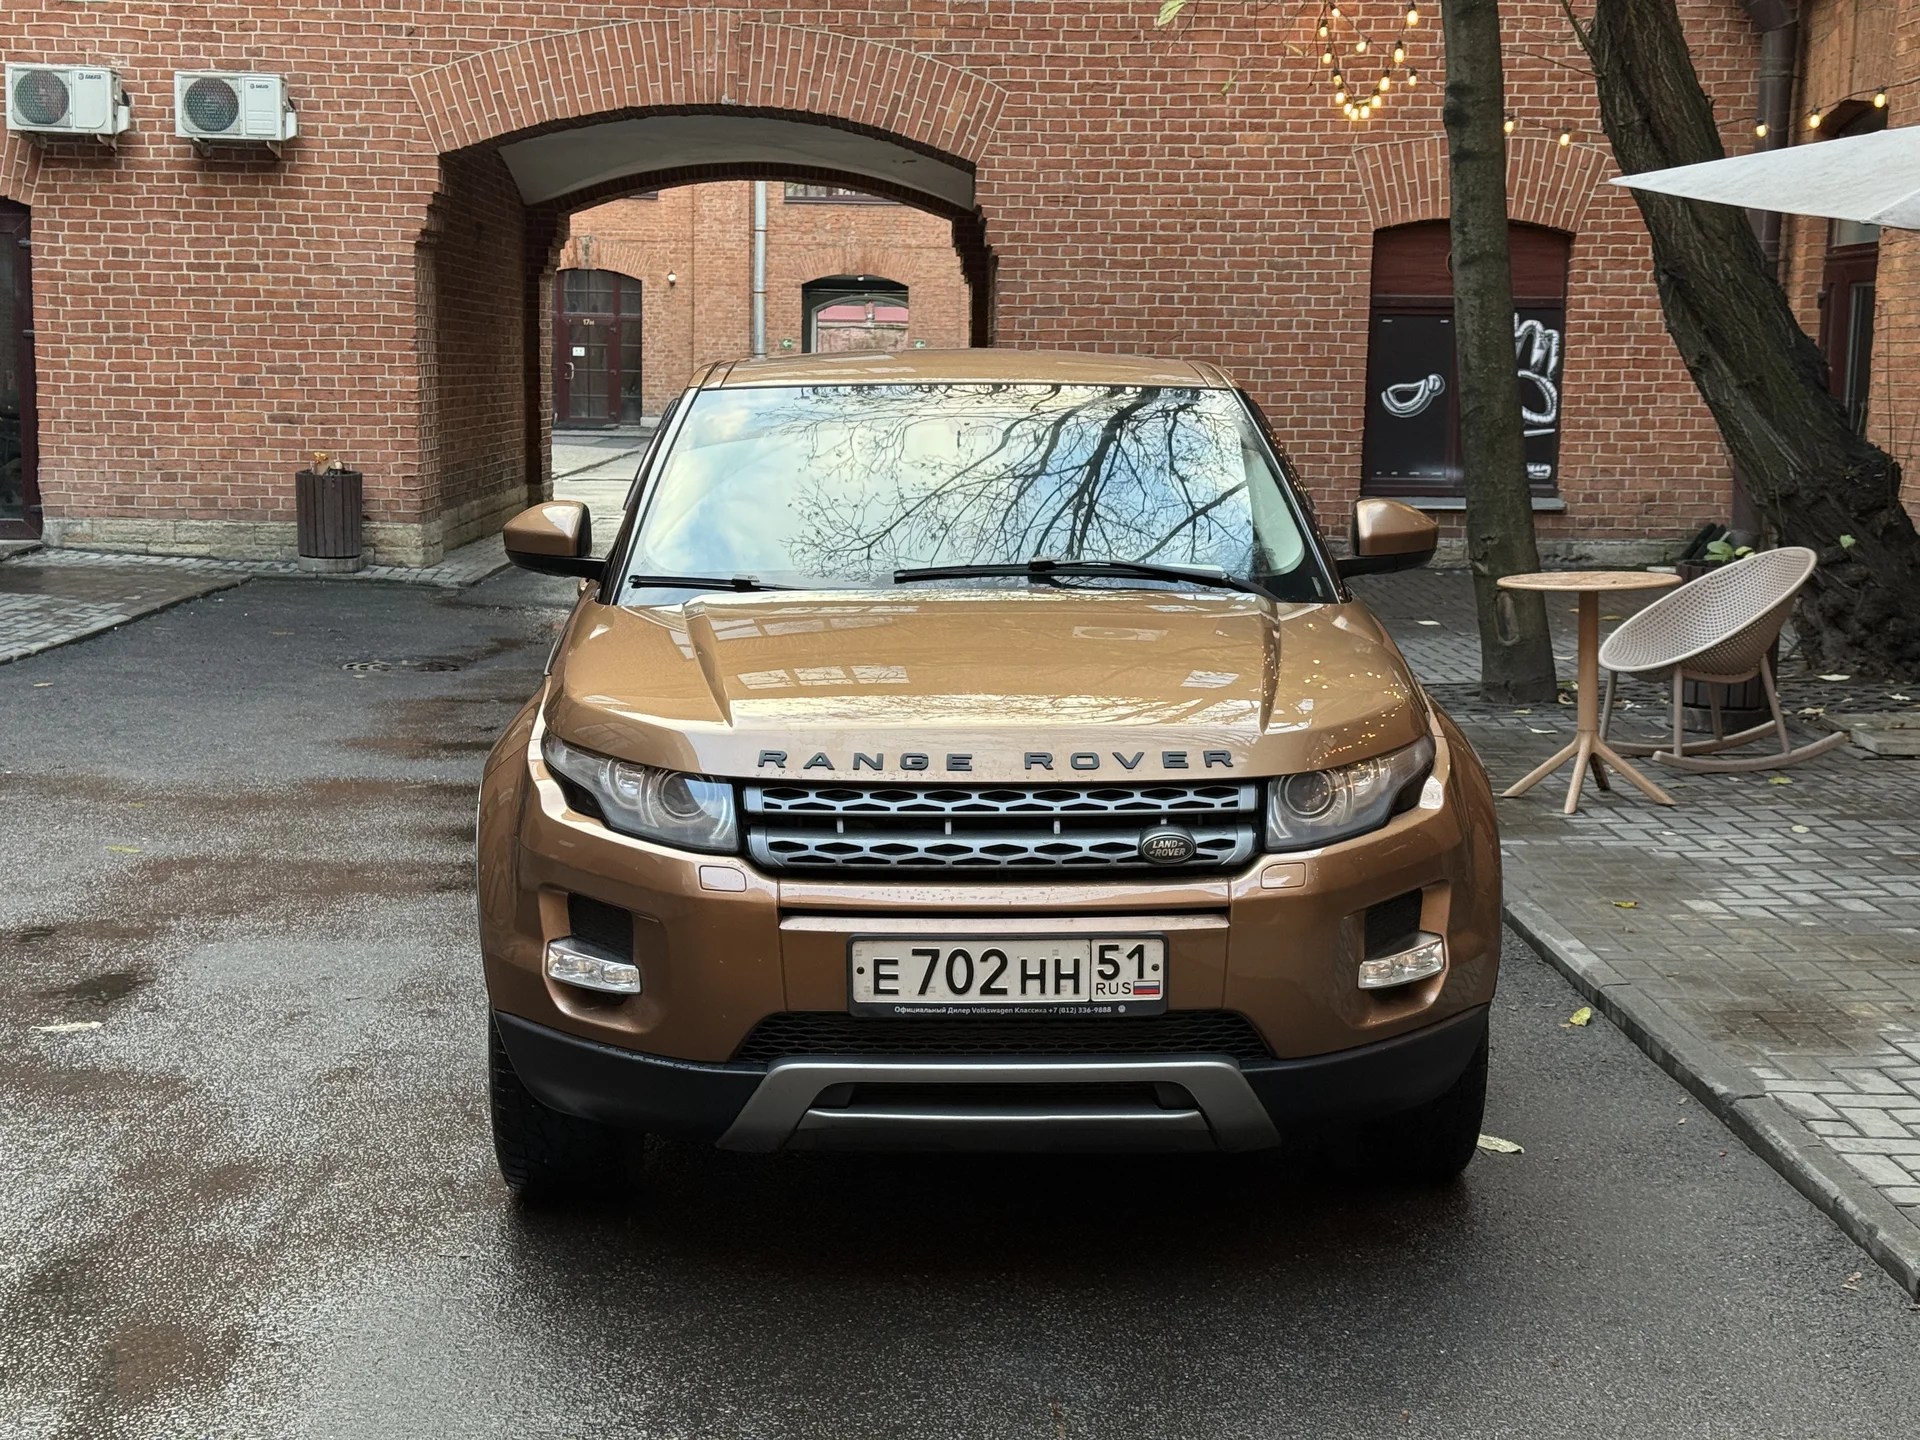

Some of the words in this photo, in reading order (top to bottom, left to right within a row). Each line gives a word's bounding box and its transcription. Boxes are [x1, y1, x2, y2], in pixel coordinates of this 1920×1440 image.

[758, 750, 972, 771] RANGE
[1024, 750, 1233, 770] ROVER
[1154, 847, 1186, 857] ROVER
[1097, 944, 1145, 980] 51
[1096, 982, 1132, 995] RUS
[894, 1006, 947, 1014] Официальный
[947, 1007, 971, 1015] Дилер
[971, 1007, 1013, 1015] Volkswagen
